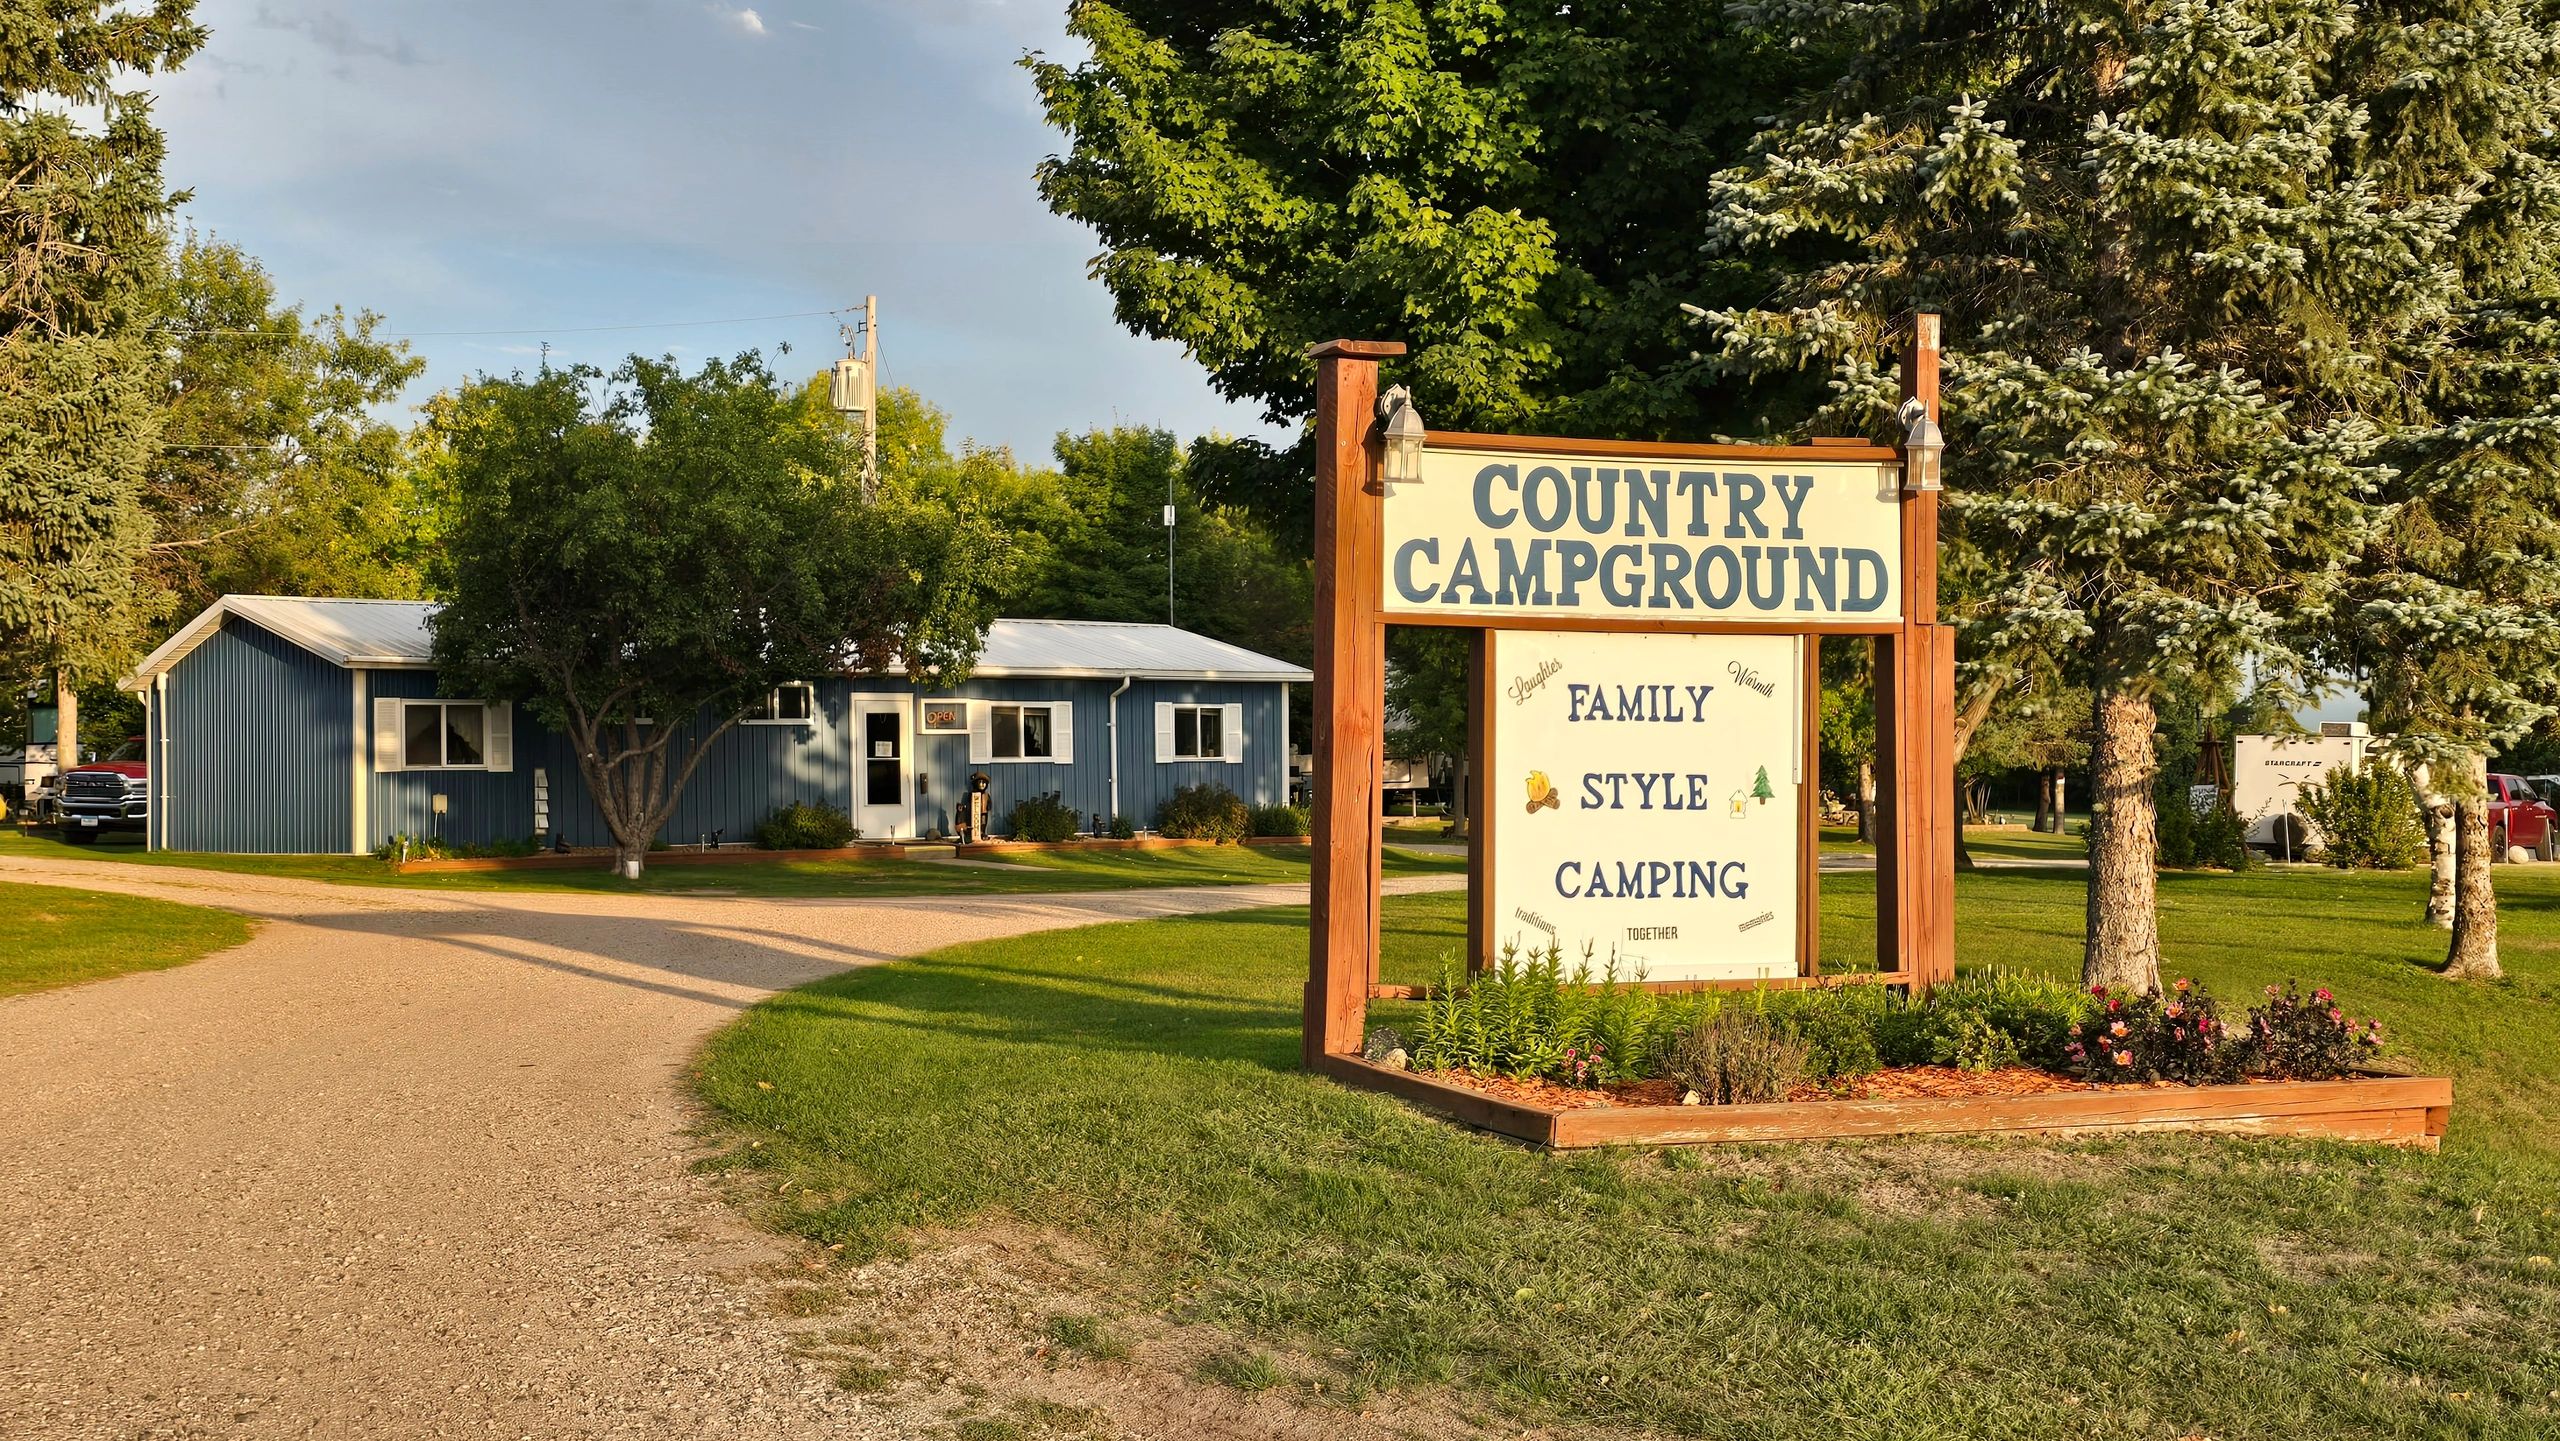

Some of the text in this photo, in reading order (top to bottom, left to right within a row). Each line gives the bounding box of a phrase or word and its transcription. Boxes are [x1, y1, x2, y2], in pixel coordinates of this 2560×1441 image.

[1473, 464, 1814, 540] COUNTRY
[1394, 537, 1889, 612] CAMPGROUND
[1508, 657, 1563, 706] Laughter
[1727, 660, 1776, 699] Warmth
[927, 711, 956, 724] OPEN
[1567, 684, 1714, 723] FAMILY
[1580, 773, 1708, 811] STYLE
[1555, 861, 1749, 900] CAMPING
[1514, 906, 1557, 935] traditions
[1626, 926, 1678, 941] TOGETHER
